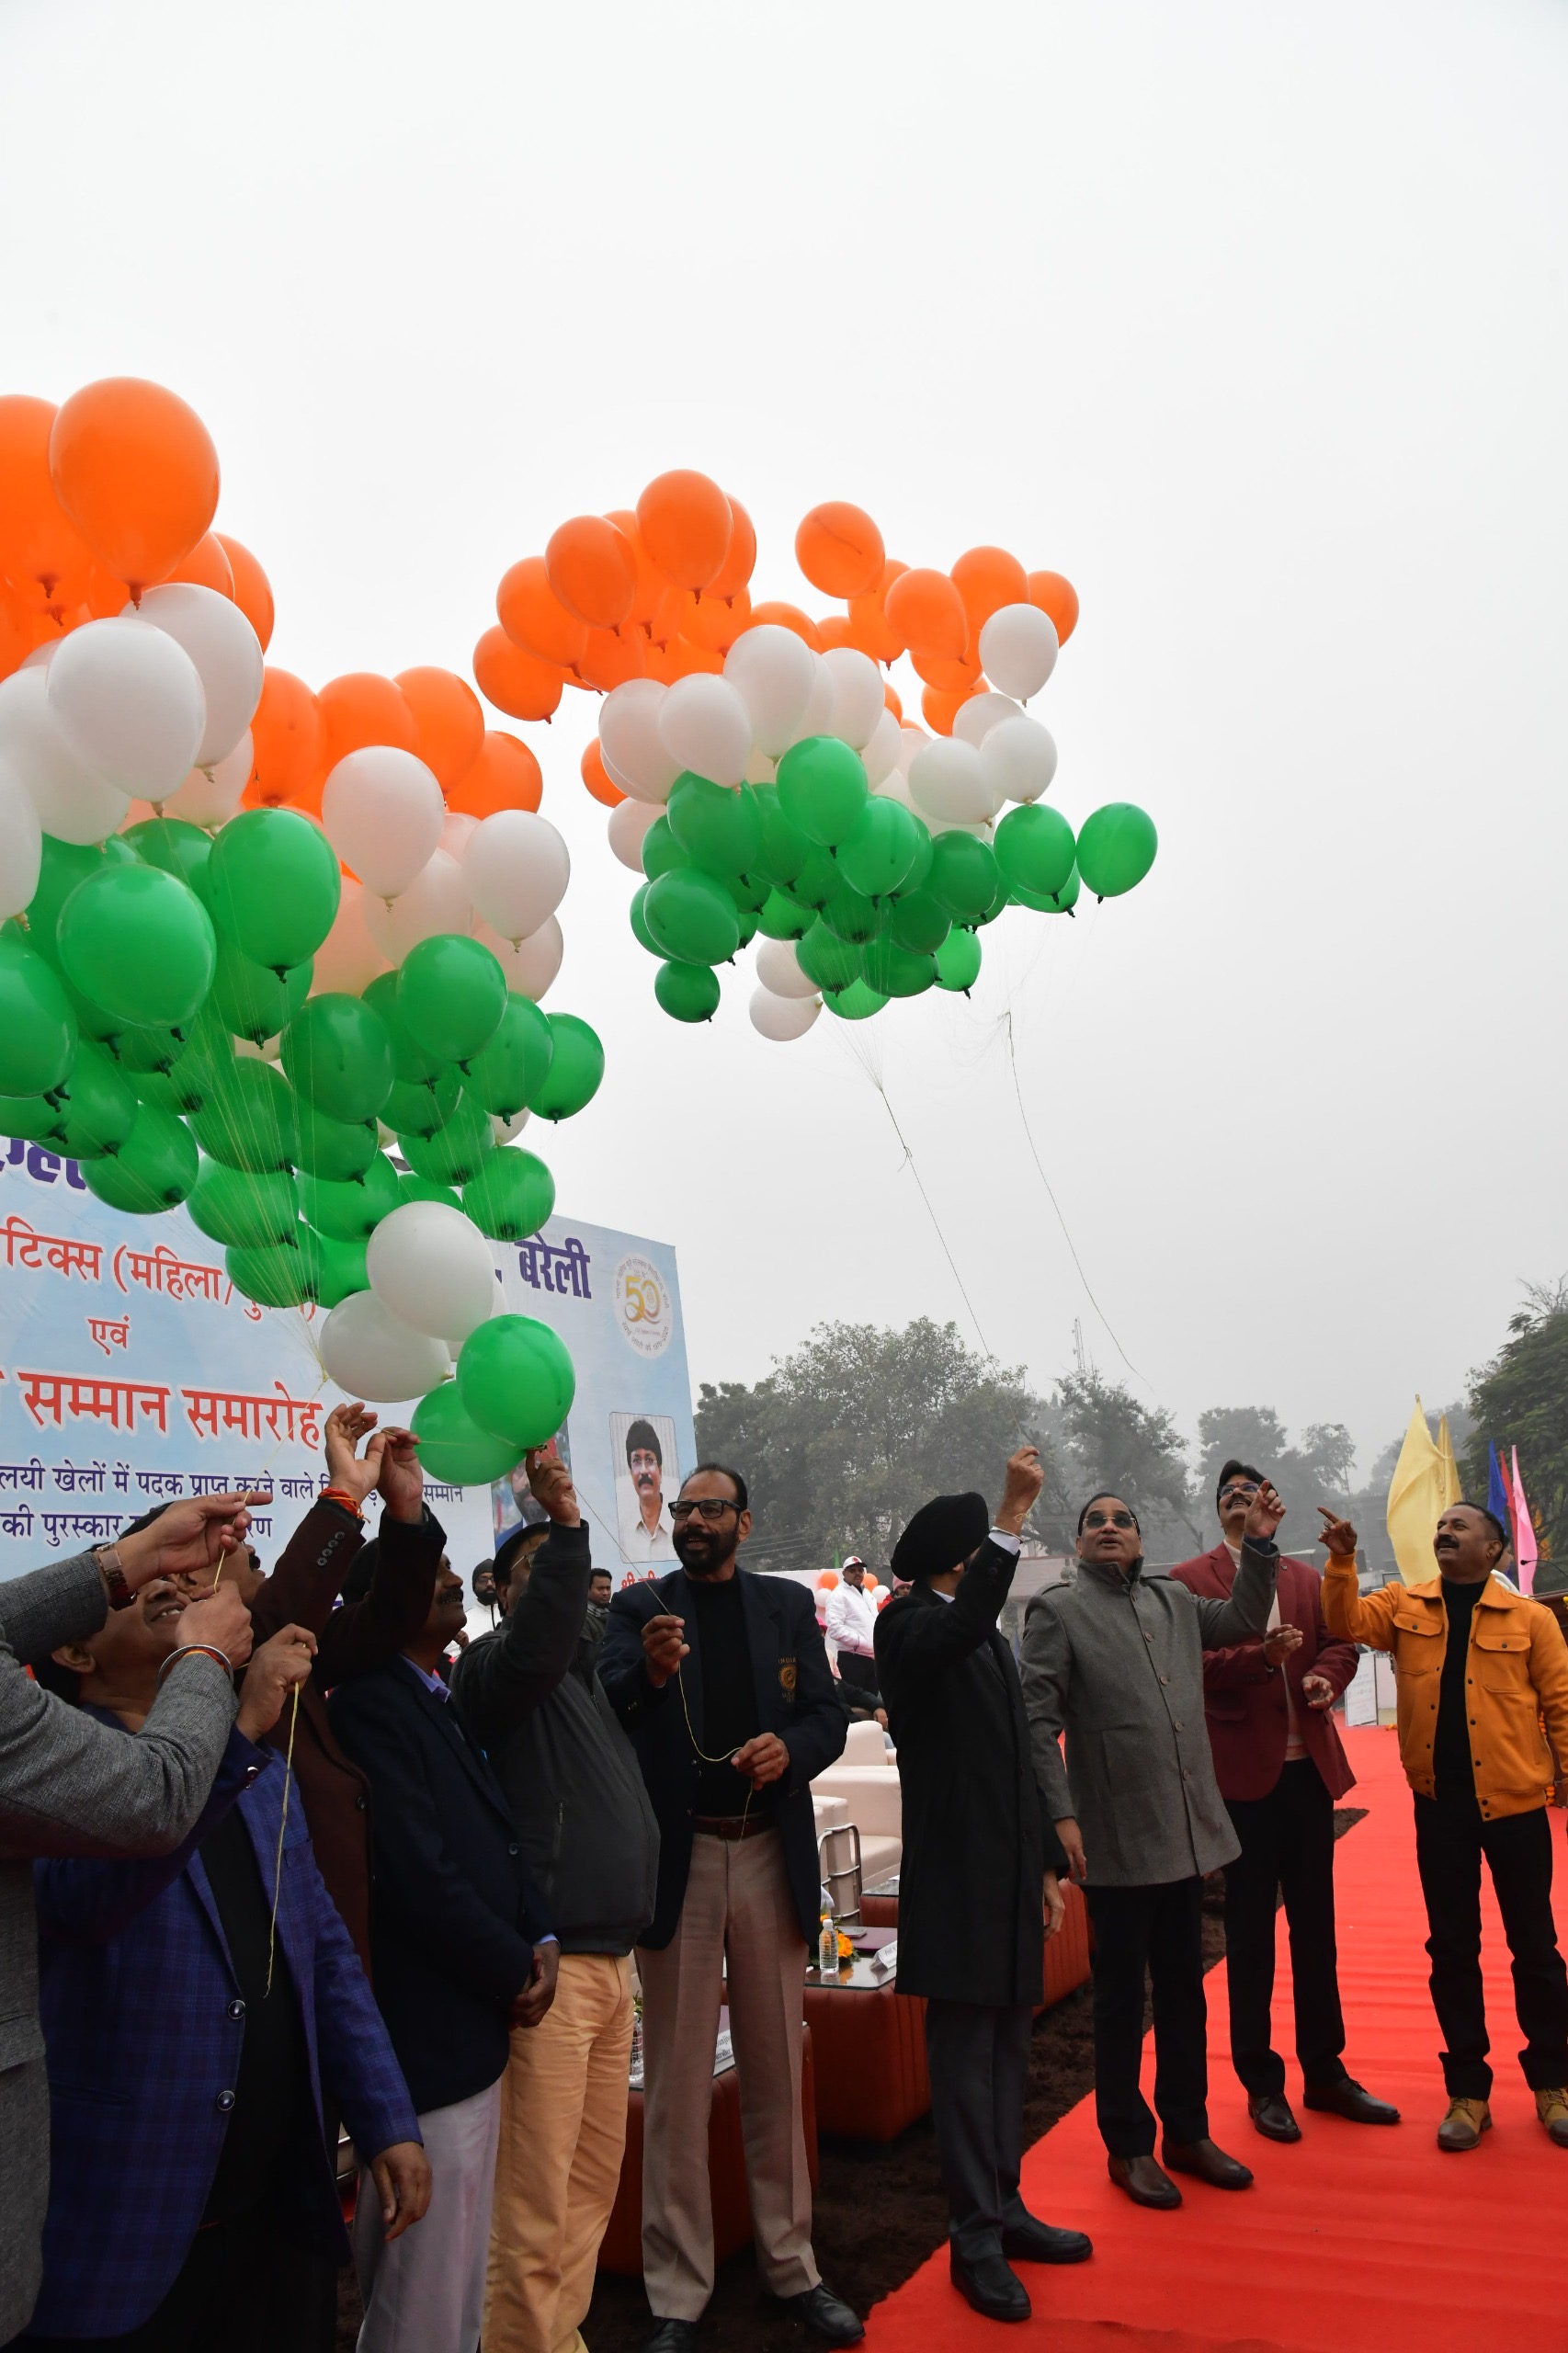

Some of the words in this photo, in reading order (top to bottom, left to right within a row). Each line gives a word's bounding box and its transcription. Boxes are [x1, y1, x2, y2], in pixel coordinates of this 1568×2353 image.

[0, 1216, 103, 1280] टिक्स
[514, 1232, 592, 1300] बरेली
[625, 1275, 661, 1324] 50
[88, 1315, 130, 1356] एवं
[17, 1372, 171, 1433] सम्मान
[181, 1381, 324, 1450] समारोह
[0, 1458, 46, 1491] लयी
[51, 1460, 107, 1493] खेलों
[112, 1462, 130, 1494] में
[135, 1472, 184, 1498] पदक
[188, 1474, 230, 1496] प्राप्त
[279, 1472, 314, 1499] वाले
[423, 1483, 463, 1503] सम्मान
[41, 1514, 123, 1547] पुरस्कार
[246, 1518, 273, 1538] रण
